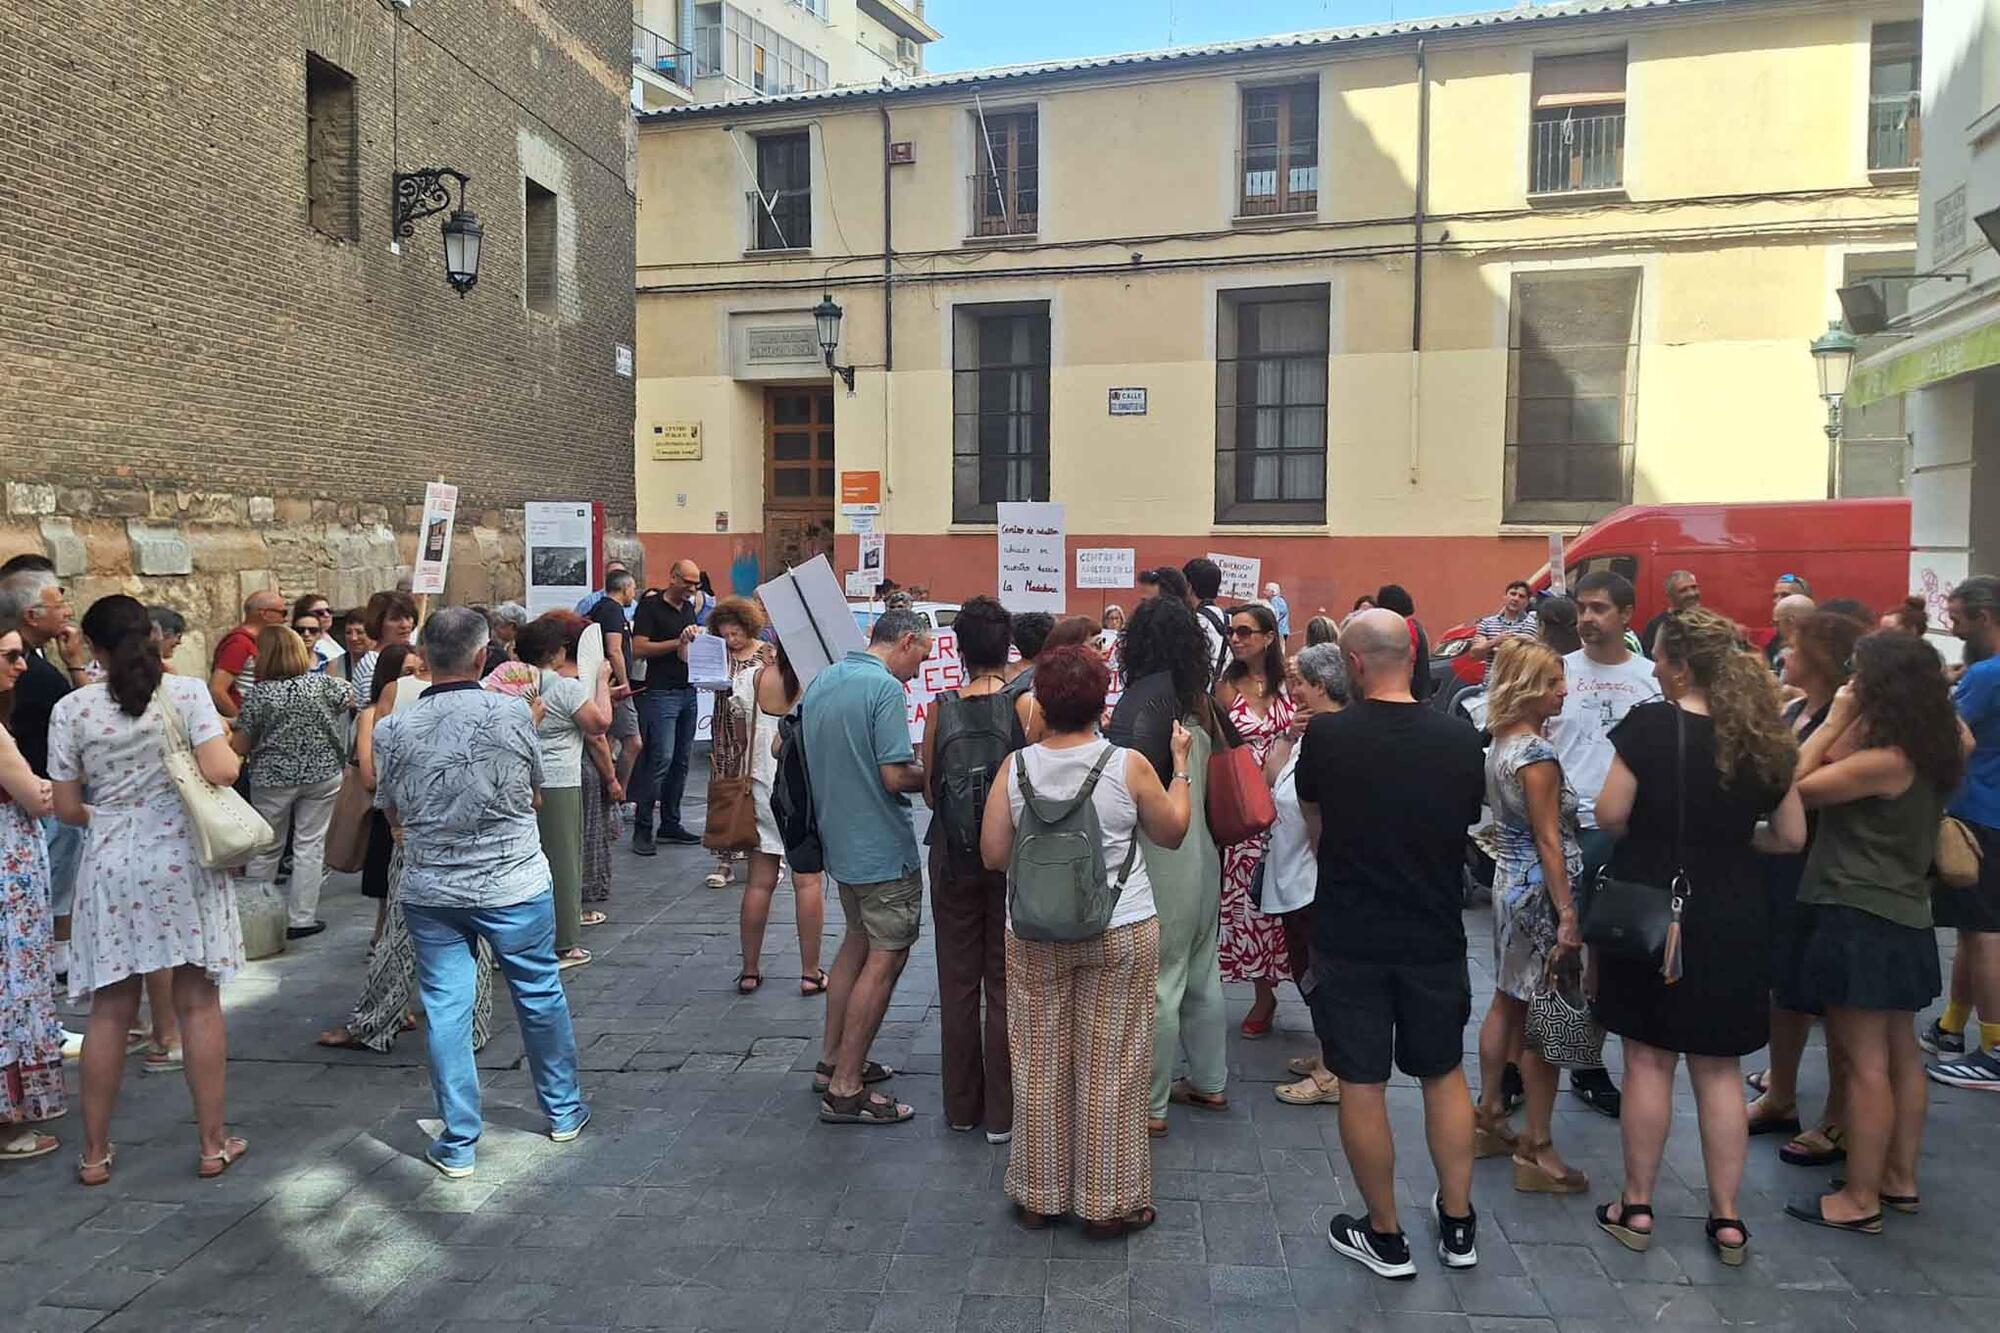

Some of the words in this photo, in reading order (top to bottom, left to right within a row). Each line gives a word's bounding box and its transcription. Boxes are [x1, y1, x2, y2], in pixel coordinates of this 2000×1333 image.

[1001, 524, 1025, 535] Centro
[1026, 526, 1034, 535] de
[1002, 580, 1013, 592] La
